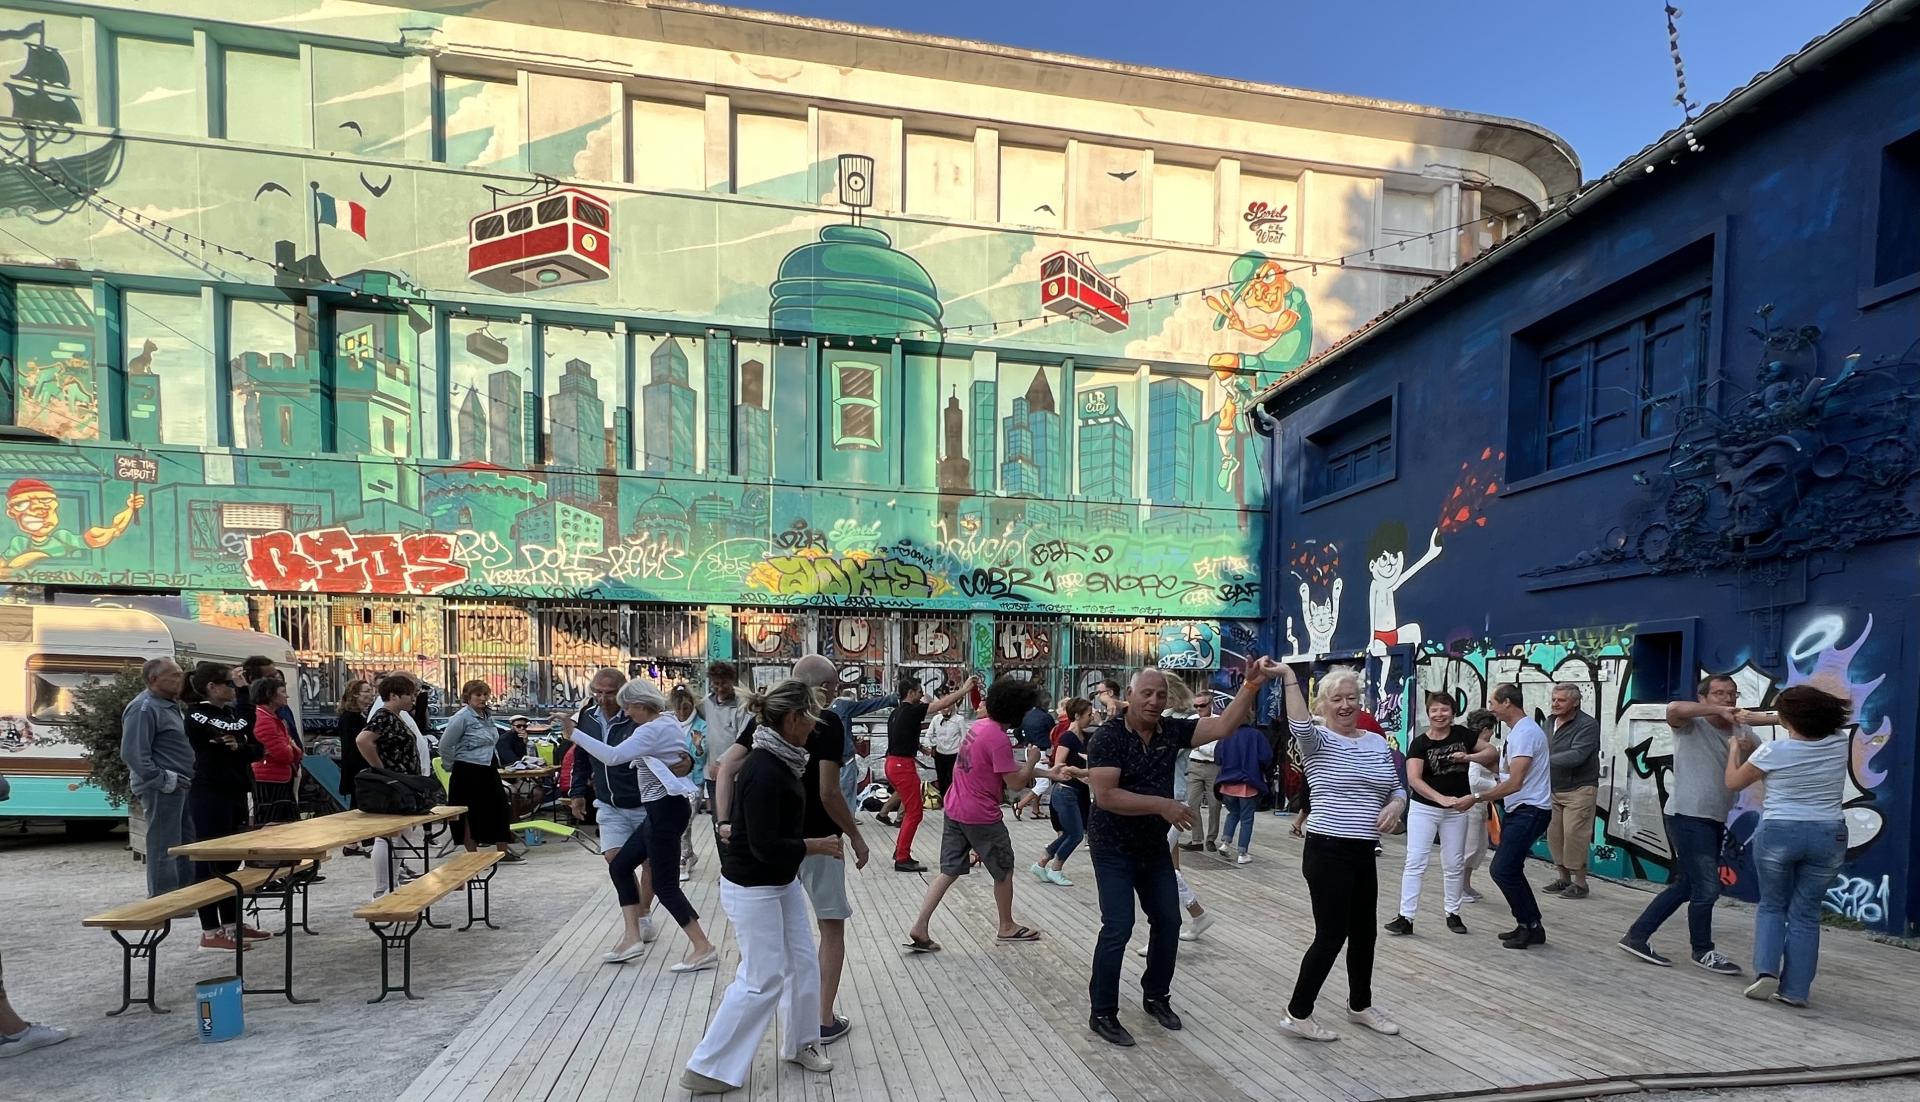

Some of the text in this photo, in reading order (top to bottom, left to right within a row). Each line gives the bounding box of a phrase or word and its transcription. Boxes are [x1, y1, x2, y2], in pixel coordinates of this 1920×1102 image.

[1088, 391, 1106, 404] LR
[118, 457, 157, 470] SAVE THE
[191, 712, 209, 724] SEA
